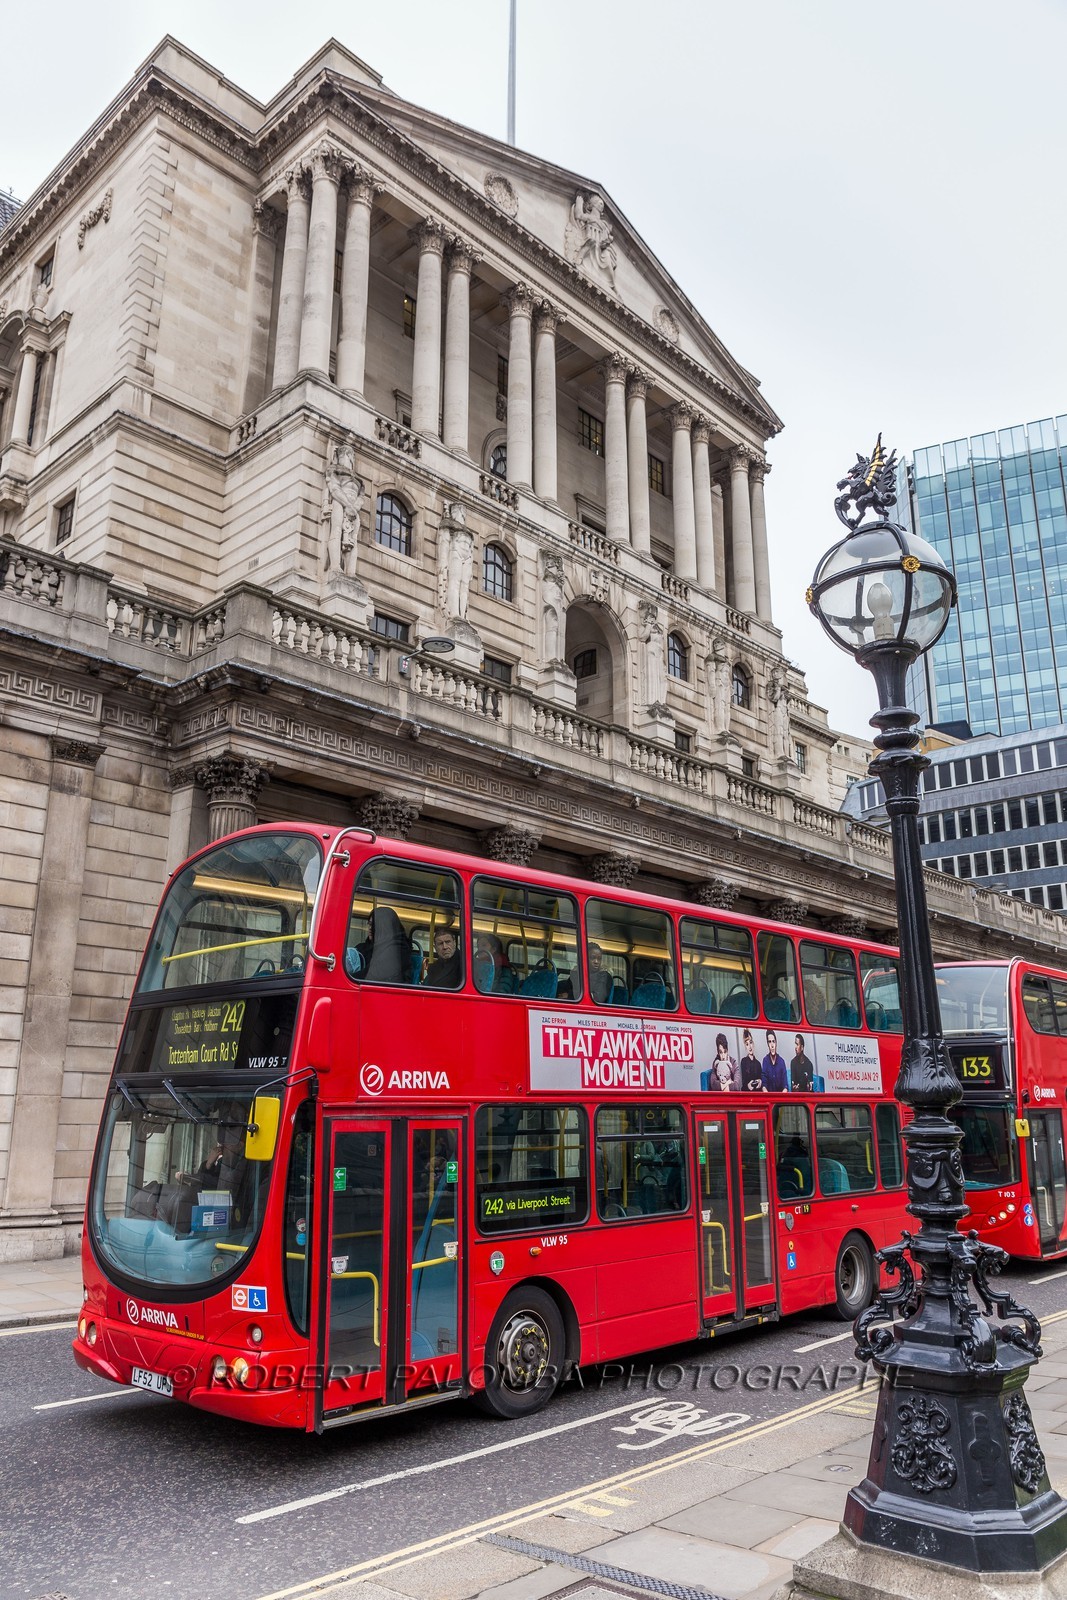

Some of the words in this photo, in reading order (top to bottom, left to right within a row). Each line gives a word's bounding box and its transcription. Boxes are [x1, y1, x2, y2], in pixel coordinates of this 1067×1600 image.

[220, 1000, 246, 1032] 242
[541, 1016, 551, 1024] ZAC
[551, 1017, 567, 1025] EFRON
[577, 1019, 591, 1027] MILES
[591, 1020, 607, 1028] TELLER
[617, 1022, 634, 1030] MICHAEL
[641, 1023, 657, 1031] JORDAN
[665, 1025, 680, 1033] IMOGEN
[680, 1026, 693, 1034] POOTS
[544, 1027, 596, 1057] THAT
[599, 1031, 692, 1061] AWKWARD
[168, 1044, 199, 1065] Tottenham
[200, 1043, 218, 1063] Court
[219, 1041, 230, 1061] Rd
[231, 1040, 239, 1061] St
[826, 1055, 835, 1063] THE
[835, 1055, 853, 1064] PERFECT
[854, 1056, 864, 1065] DATE
[248, 1057, 268, 1068] VLW
[268, 1056, 280, 1068] 95
[962, 1056, 991, 1077] 133
[387, 1070, 451, 1089] ARRIVA
[582, 1058, 664, 1087] MOMENT
[827, 1070, 835, 1080] IN
[835, 1070, 861, 1081] CINEMAS
[861, 1071, 872, 1081] JAN
[872, 1072, 879, 1082] 29
[1040, 1088, 1057, 1099] ARRIVA
[484, 1198, 505, 1215] 242
[505, 1201, 516, 1210] via
[517, 1195, 549, 1210] Liverpool
[550, 1195, 571, 1206] Street
[540, 1236, 558, 1248] VLW
[558, 1234, 568, 1245] 95
[140, 1306, 179, 1329] ARRIVA
[132, 1369, 153, 1387] LF52
